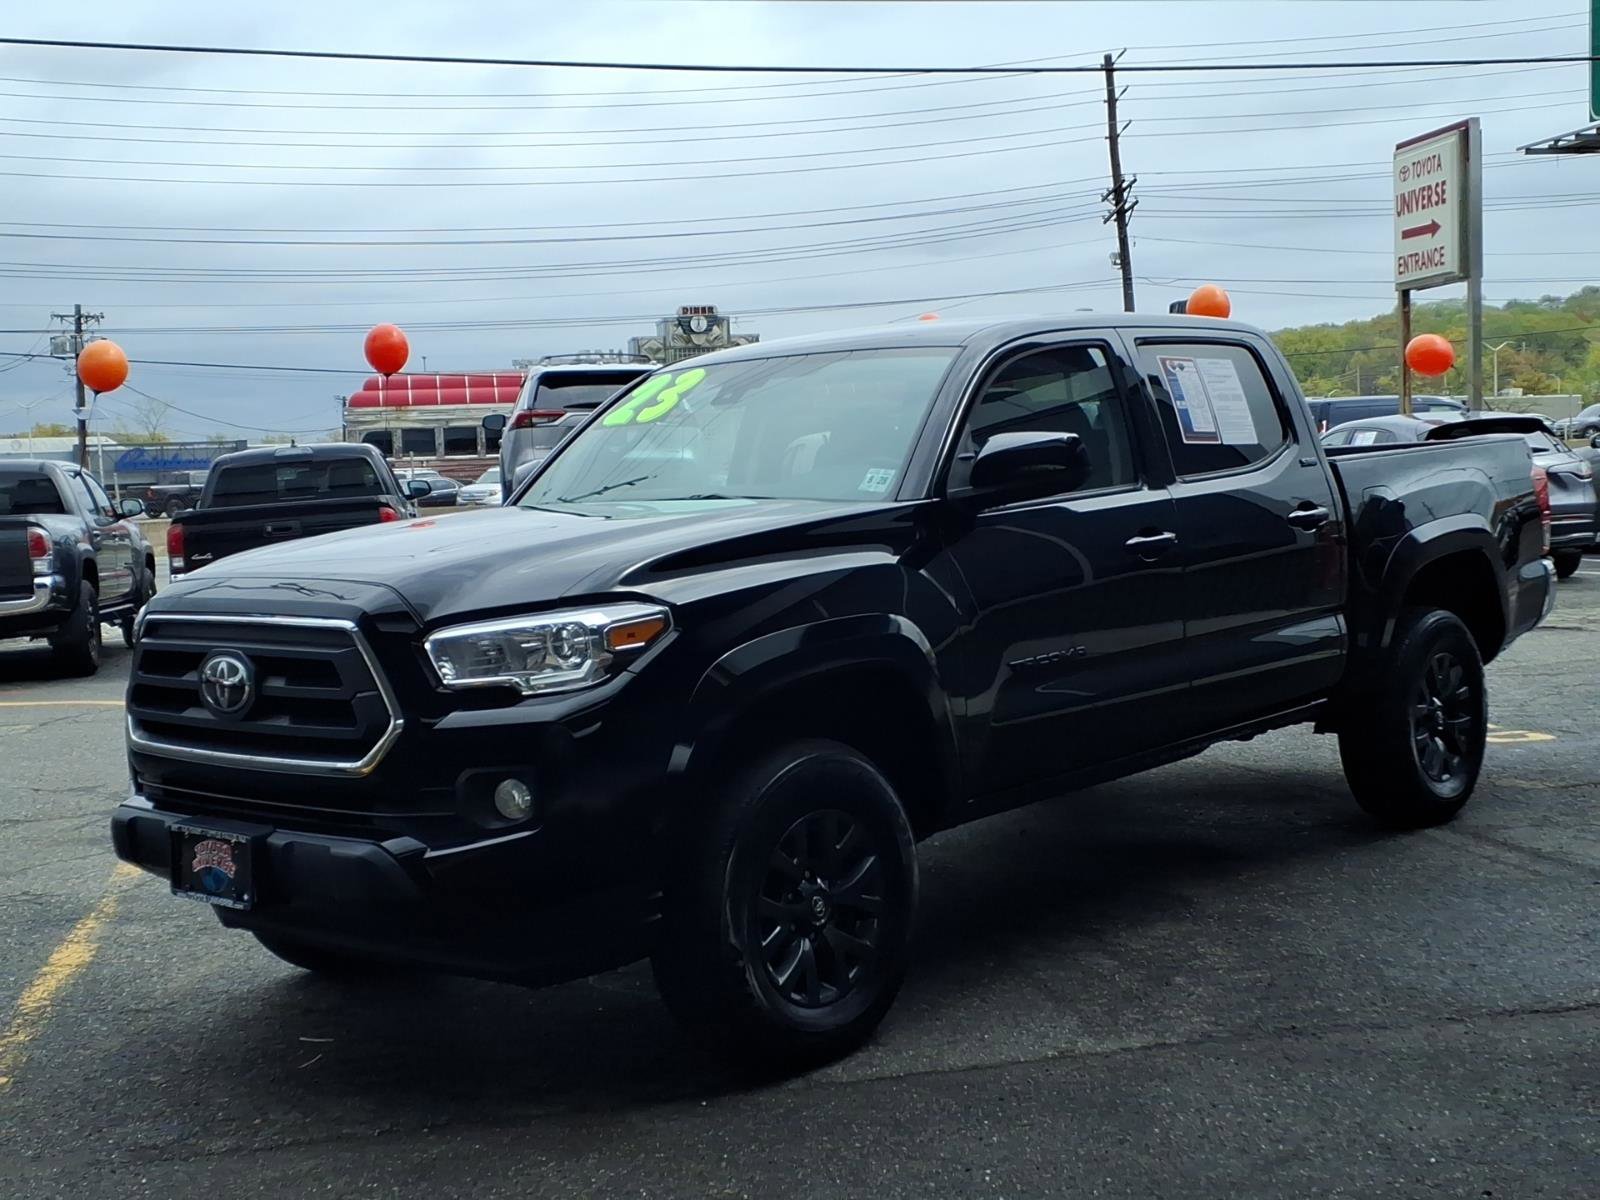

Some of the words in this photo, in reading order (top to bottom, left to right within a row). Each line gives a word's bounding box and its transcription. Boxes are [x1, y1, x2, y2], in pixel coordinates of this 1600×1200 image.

[1412, 153, 1442, 179] TOYOTA
[1396, 180, 1447, 217] UNIVERSE
[1398, 246, 1445, 275] ENTRANCE
[682, 306, 715, 315] DINER
[602, 368, 706, 428] 23
